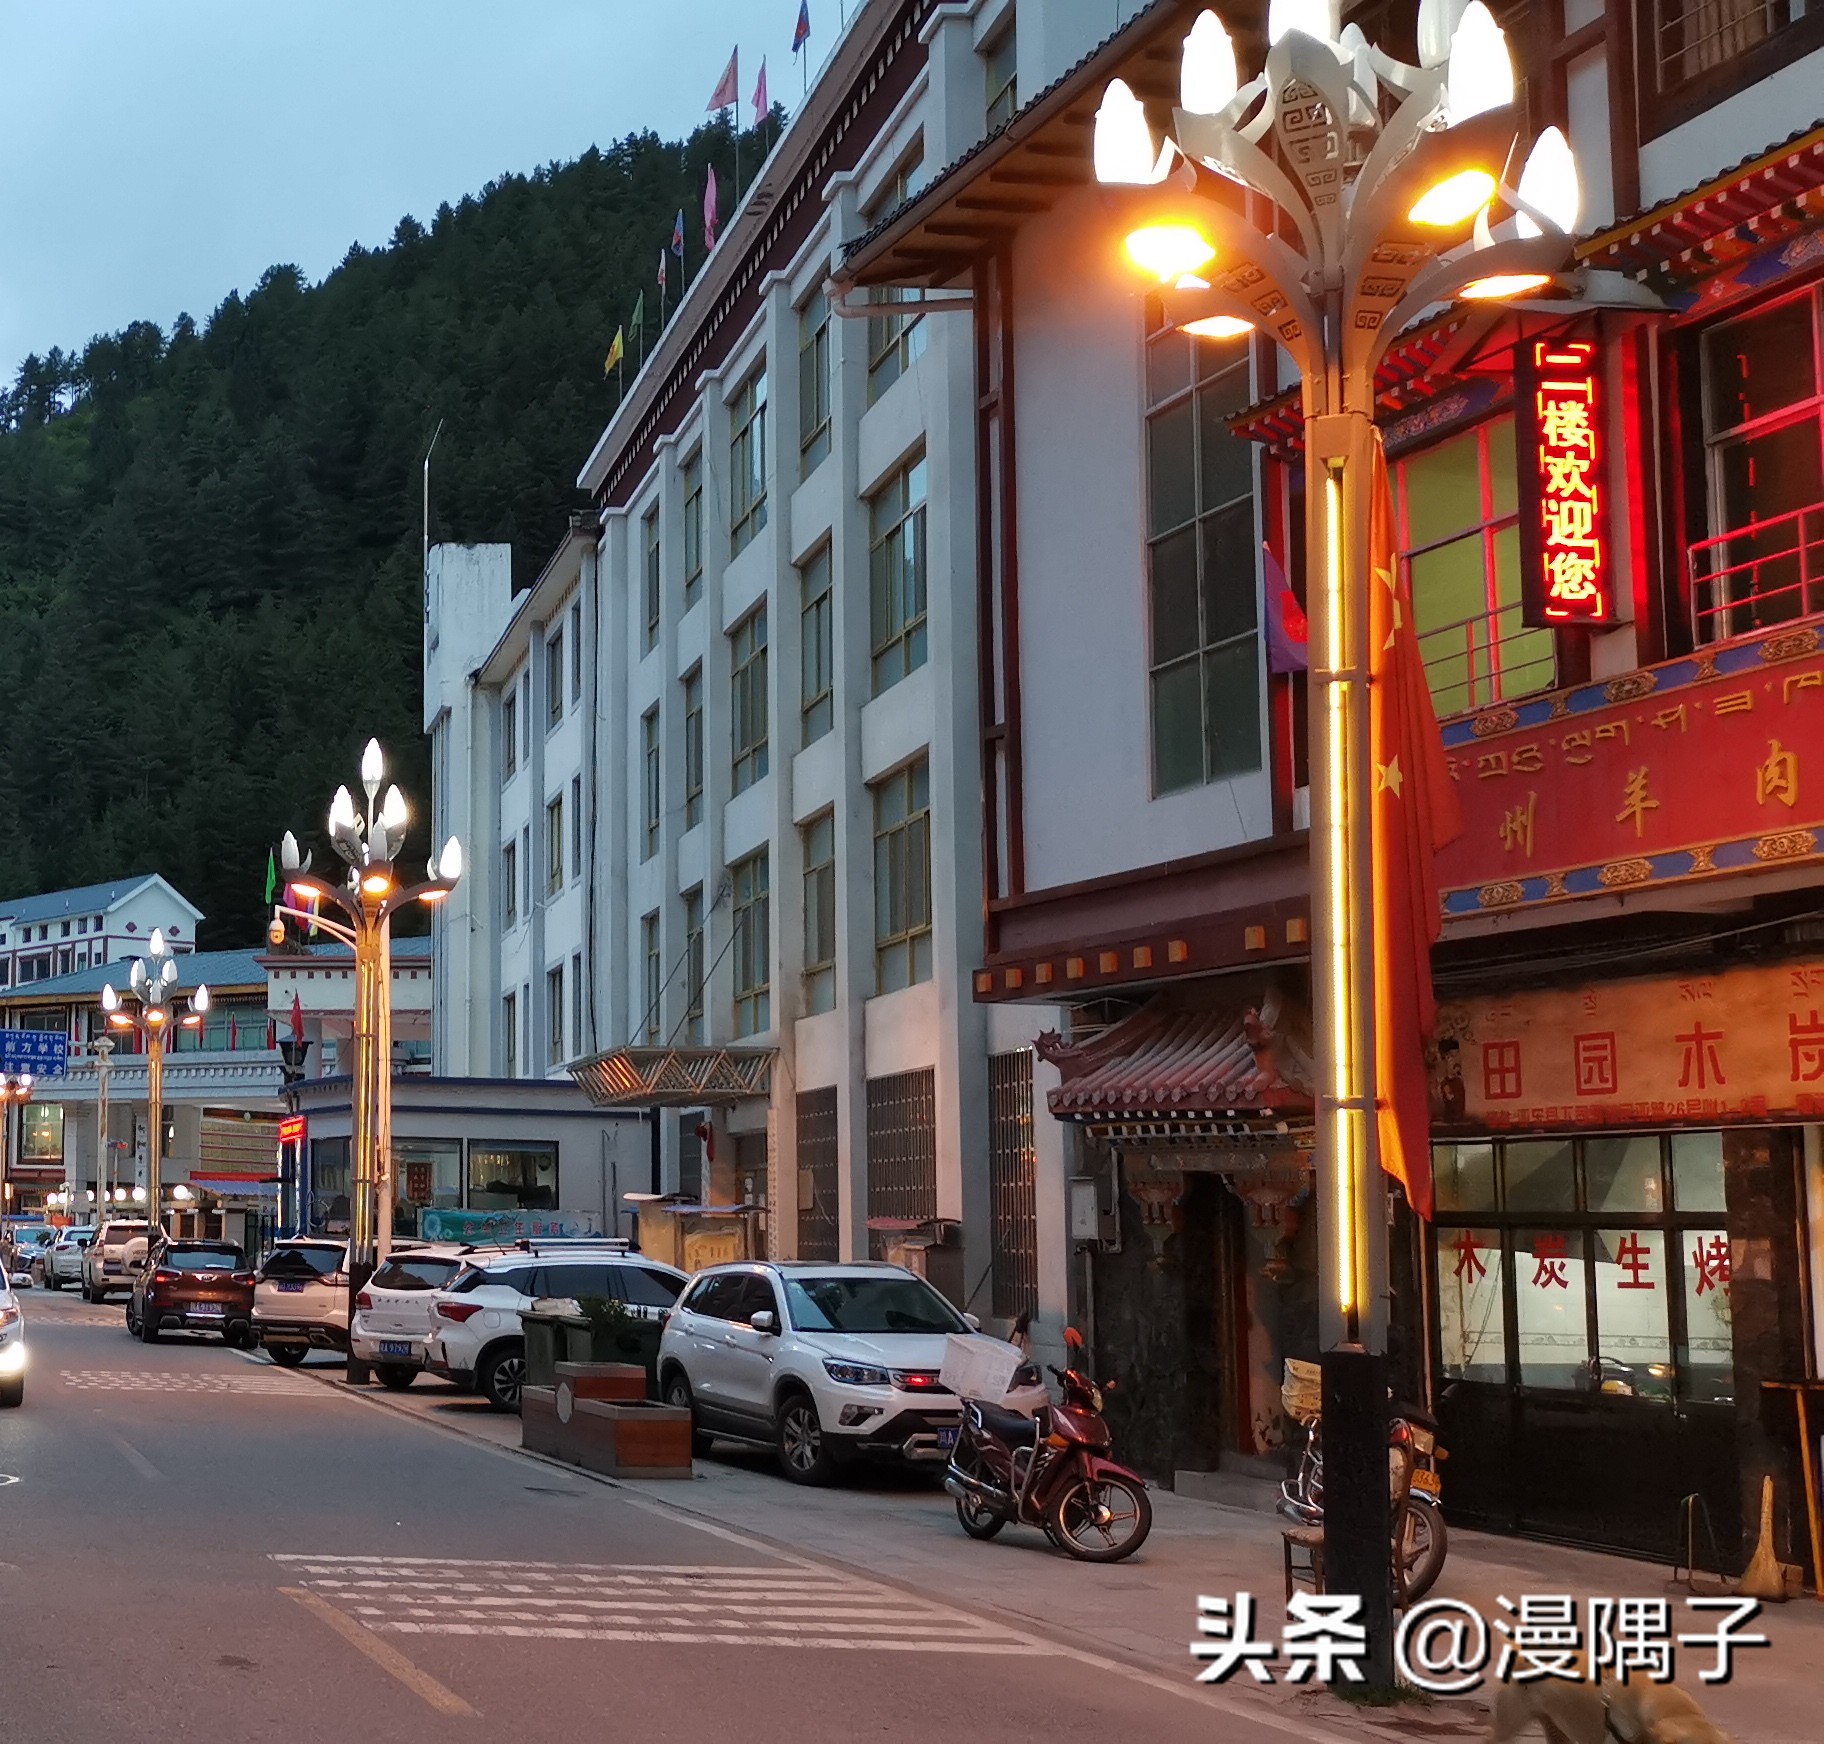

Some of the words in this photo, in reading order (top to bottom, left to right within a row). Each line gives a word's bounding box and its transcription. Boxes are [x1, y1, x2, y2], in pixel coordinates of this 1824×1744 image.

[1541, 355, 1596, 600] 二楼欢迎您
[1499, 738, 1798, 858] 州羊肉
[1453, 1230, 1730, 1296] 木炭生烤
